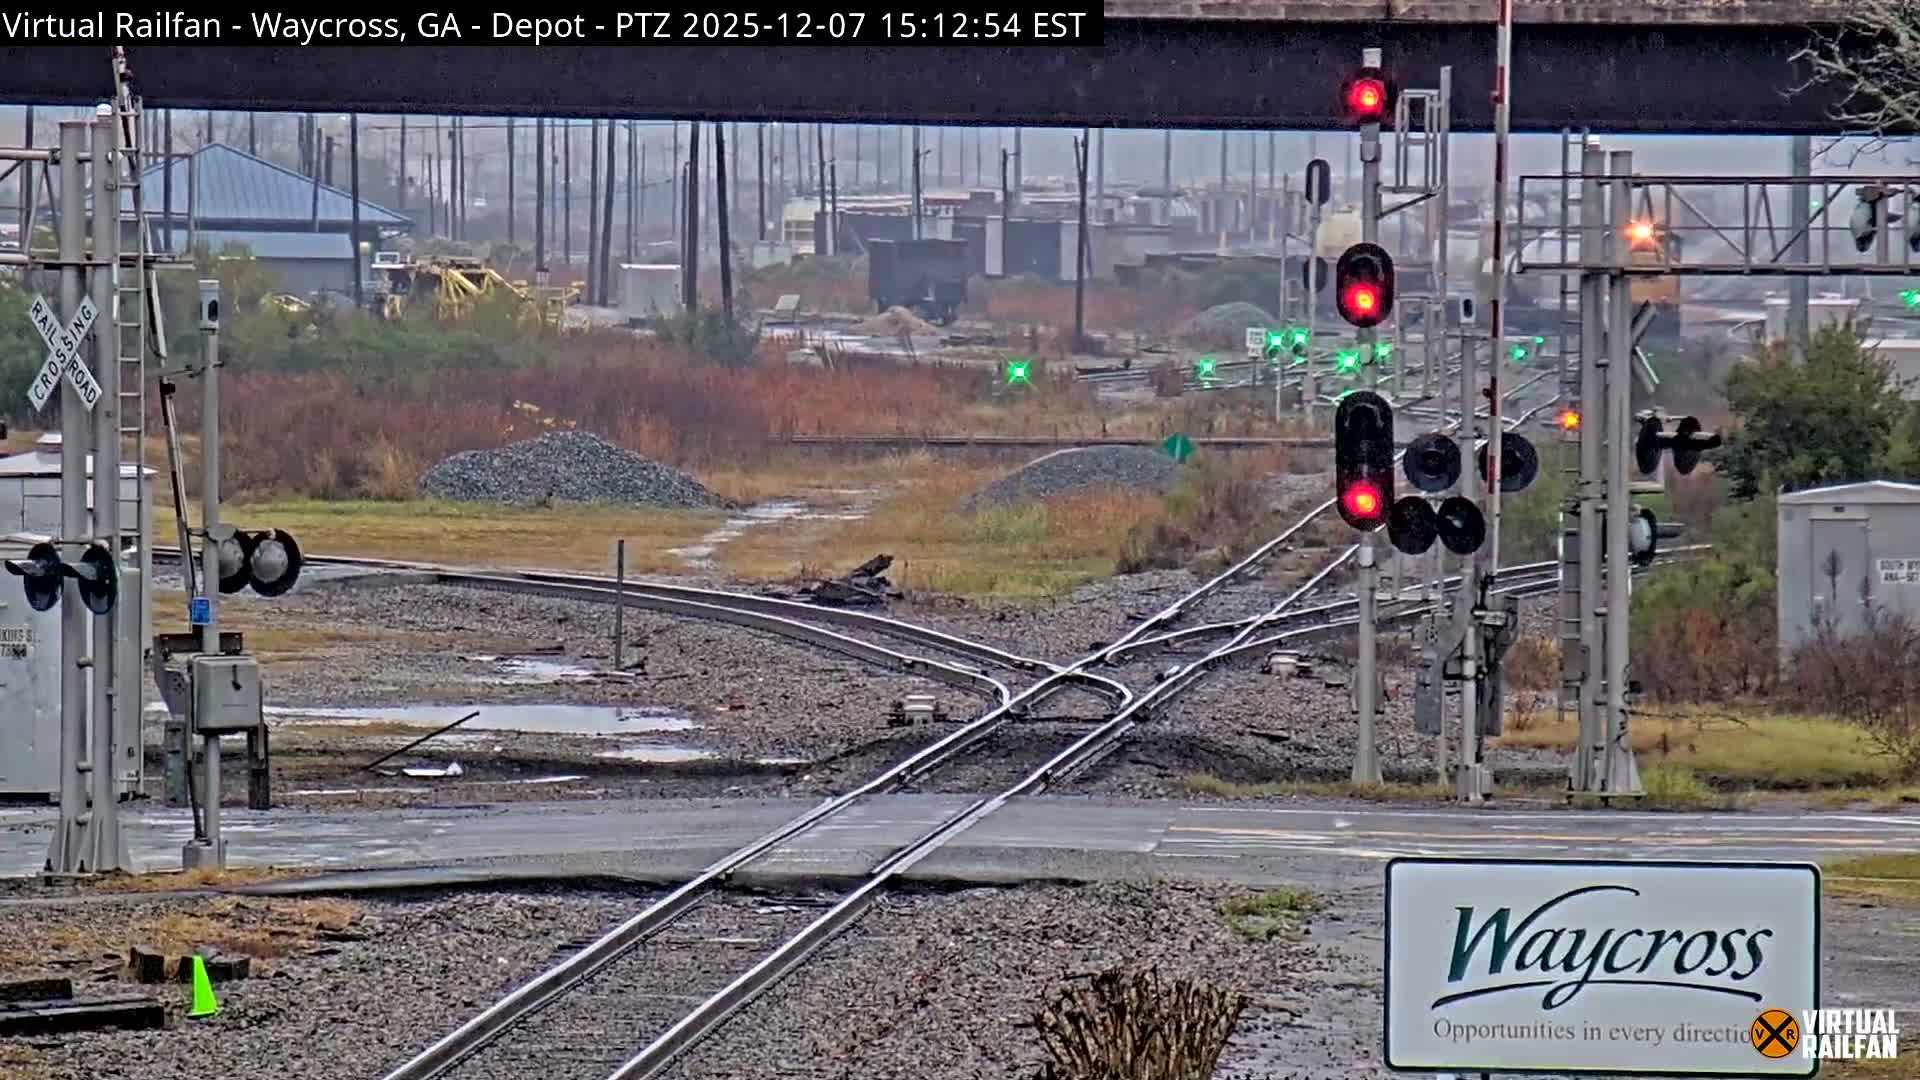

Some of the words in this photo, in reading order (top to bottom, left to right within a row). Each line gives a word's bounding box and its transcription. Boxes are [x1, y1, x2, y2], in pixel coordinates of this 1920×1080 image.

[31, 300, 58, 347] RAIL
[68, 359, 97, 404] ROAD
[33, 304, 92, 401] CROSSING
[1447, 884, 1774, 1011] Waycross
[1433, 1017, 1576, 1044] Opportunities
[1583, 1020, 1602, 1041] in
[1608, 1025, 1666, 1047] every
[1672, 1022, 1752, 1044] directio
